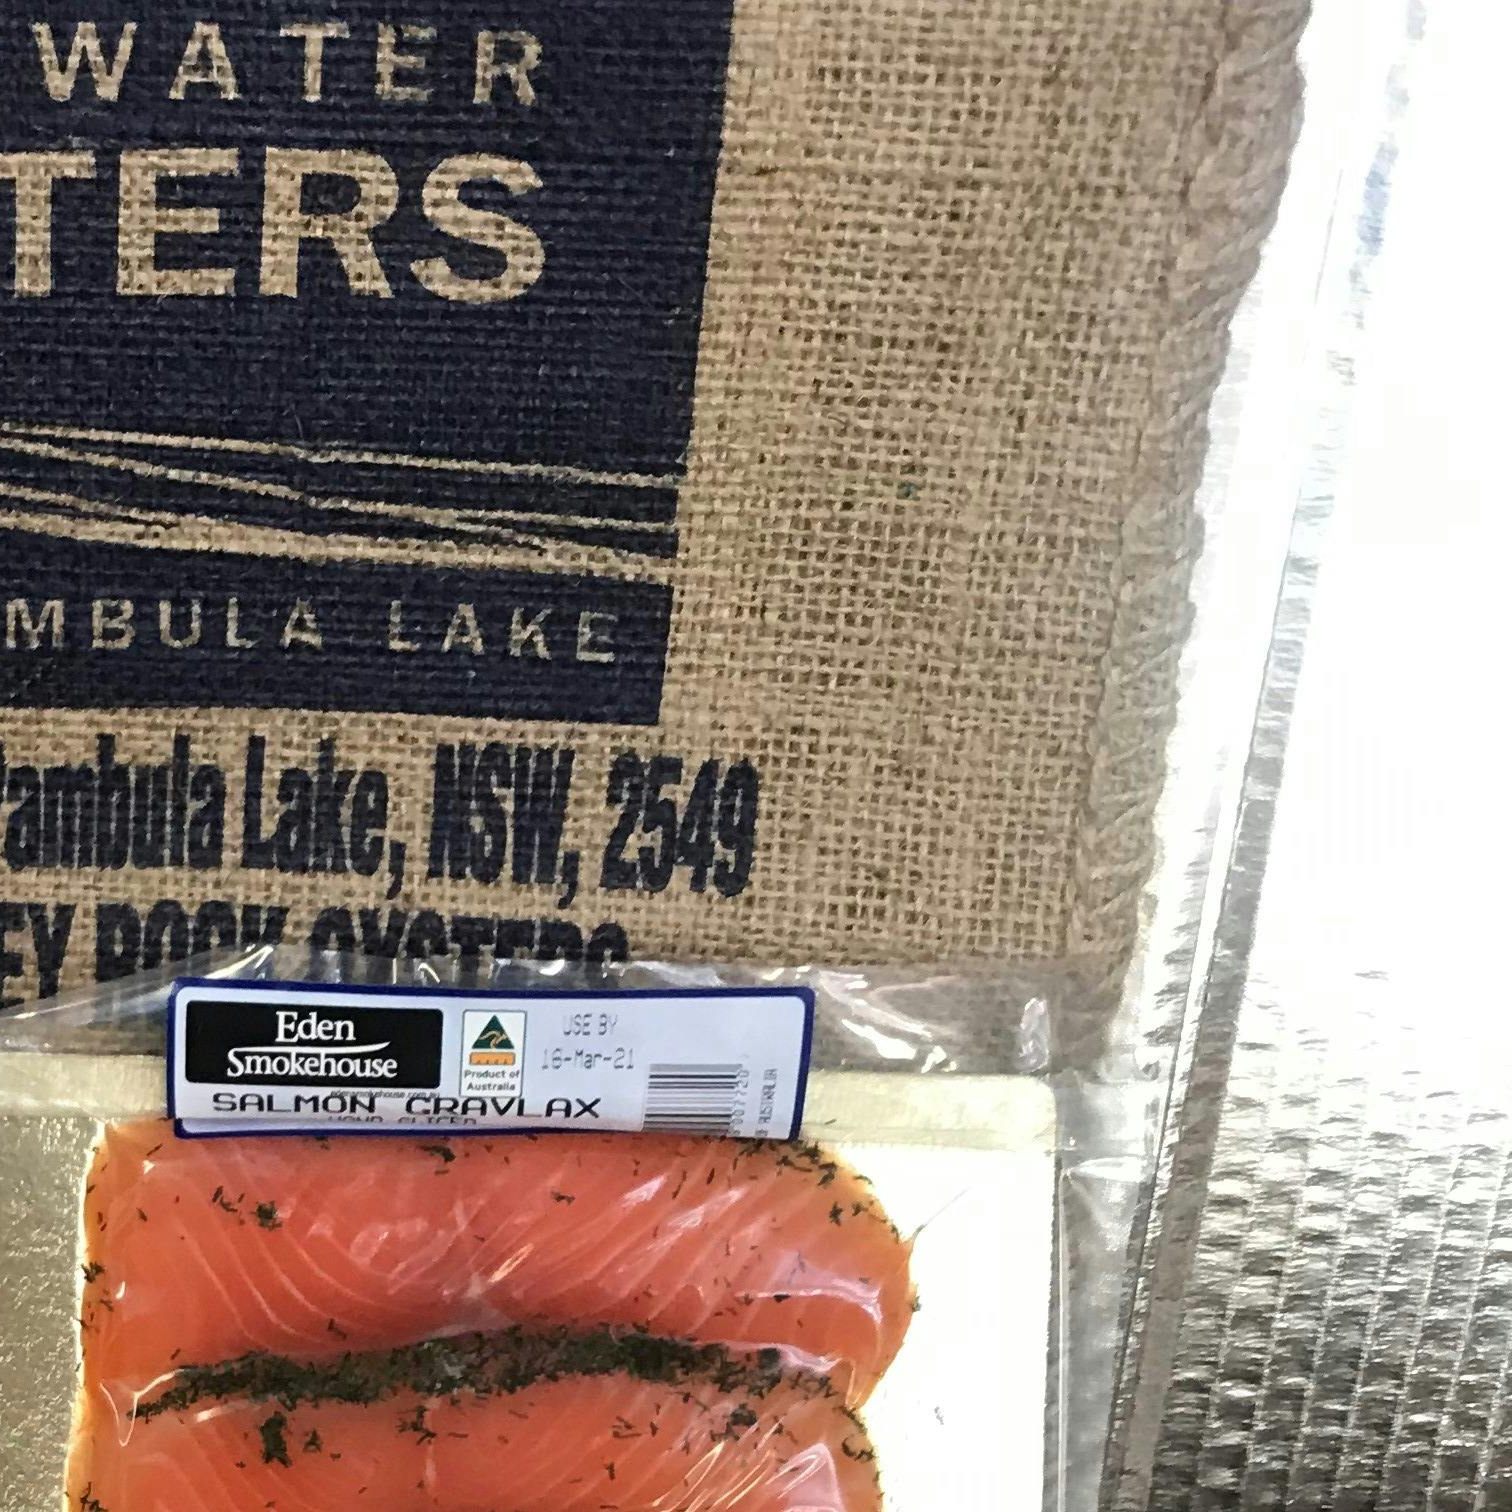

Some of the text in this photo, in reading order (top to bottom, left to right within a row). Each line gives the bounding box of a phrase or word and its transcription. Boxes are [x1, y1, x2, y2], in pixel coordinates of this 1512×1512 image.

[387, 600, 622, 666] LAKE
[242, 735, 406, 900] Lake,
[428, 743, 583, 910] NSW,
[600, 752, 761, 900] 2549
[274, 1010, 356, 1043] Eden
[563, 1013, 619, 1037] USE BY
[226, 1050, 398, 1079] Smokehouse
[463, 1067, 521, 1080] Product of
[466, 1081, 517, 1092] Australia
[211, 1091, 378, 1115] SALMON
